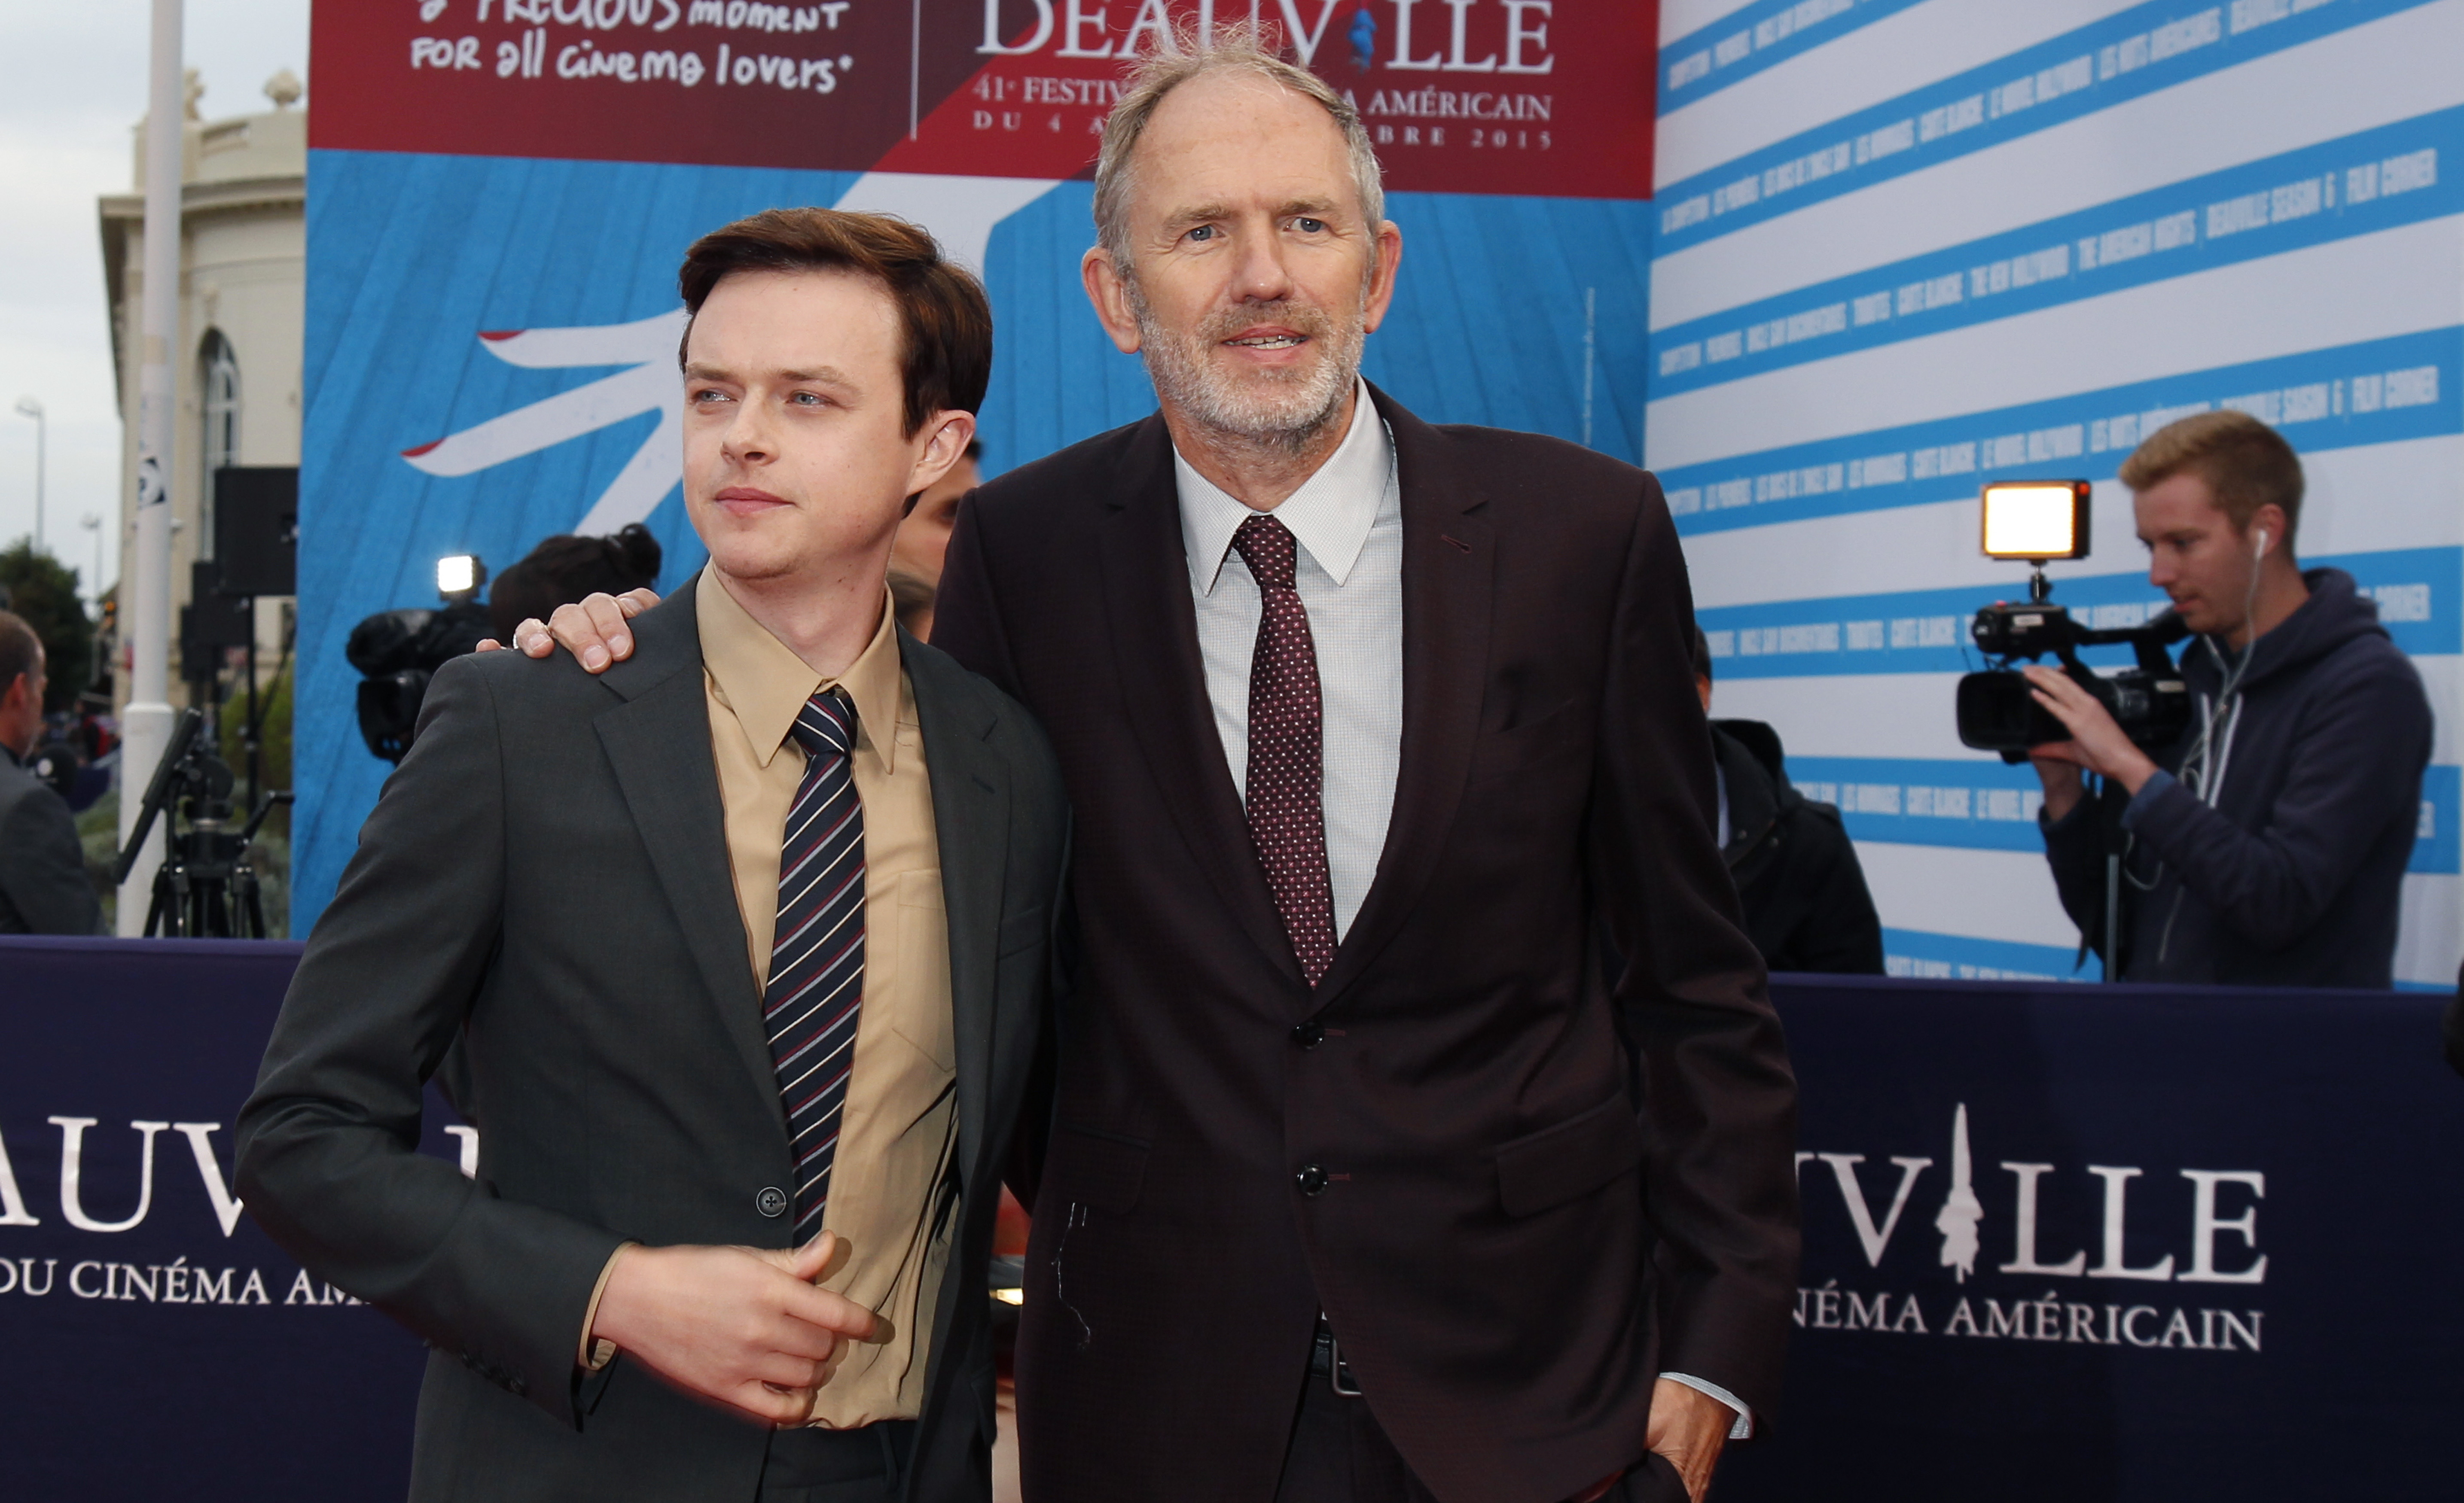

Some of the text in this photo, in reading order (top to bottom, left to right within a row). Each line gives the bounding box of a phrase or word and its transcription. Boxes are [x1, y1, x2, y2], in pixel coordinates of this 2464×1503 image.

[410, 36, 482, 70] FOR
[496, 27, 547, 78] all
[973, 110, 1022, 131] DU
[1048, 113, 1061, 133] 4
[1022, 76, 1130, 106] FESTIV
[1366, 84, 1552, 122] AMÉRICAIN
[69, 1255, 271, 1306] CINÉMA
[1943, 1290, 2265, 1352] AMÉRICAIN
